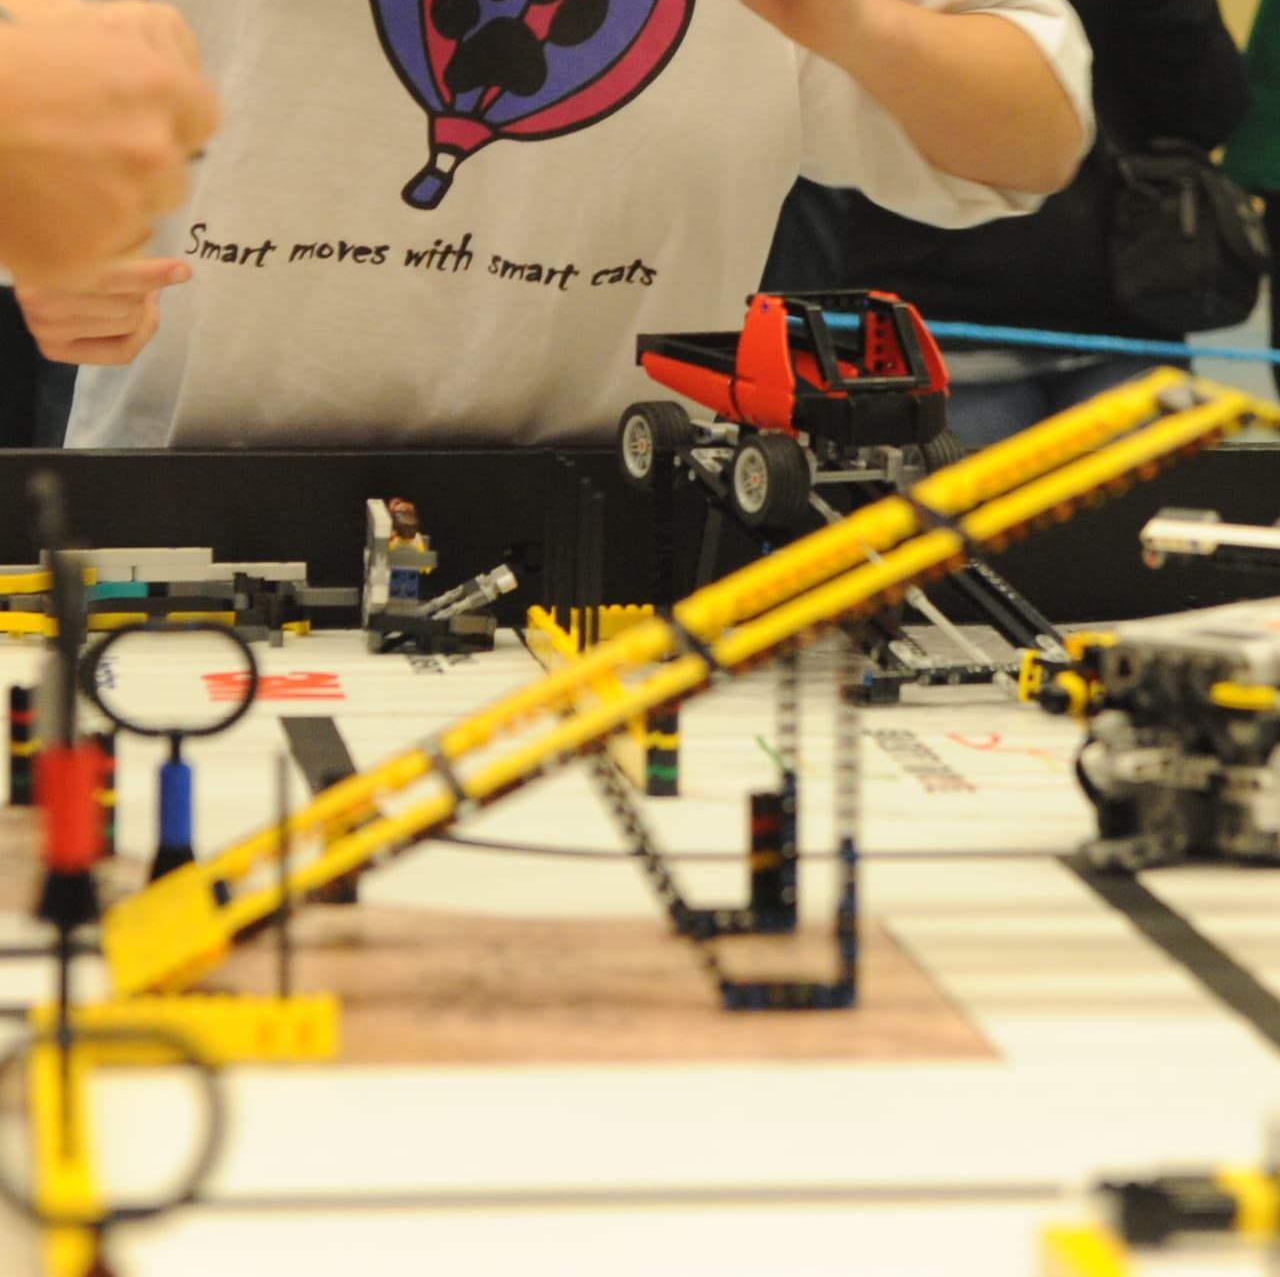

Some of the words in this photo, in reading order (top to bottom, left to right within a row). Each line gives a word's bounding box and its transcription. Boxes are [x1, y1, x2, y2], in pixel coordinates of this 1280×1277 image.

[185, 223, 276, 268] Smart
[288, 239, 390, 266] moves
[404, 233, 474, 273] with
[488, 254, 580, 291] smart
[590, 258, 658, 287] cats
